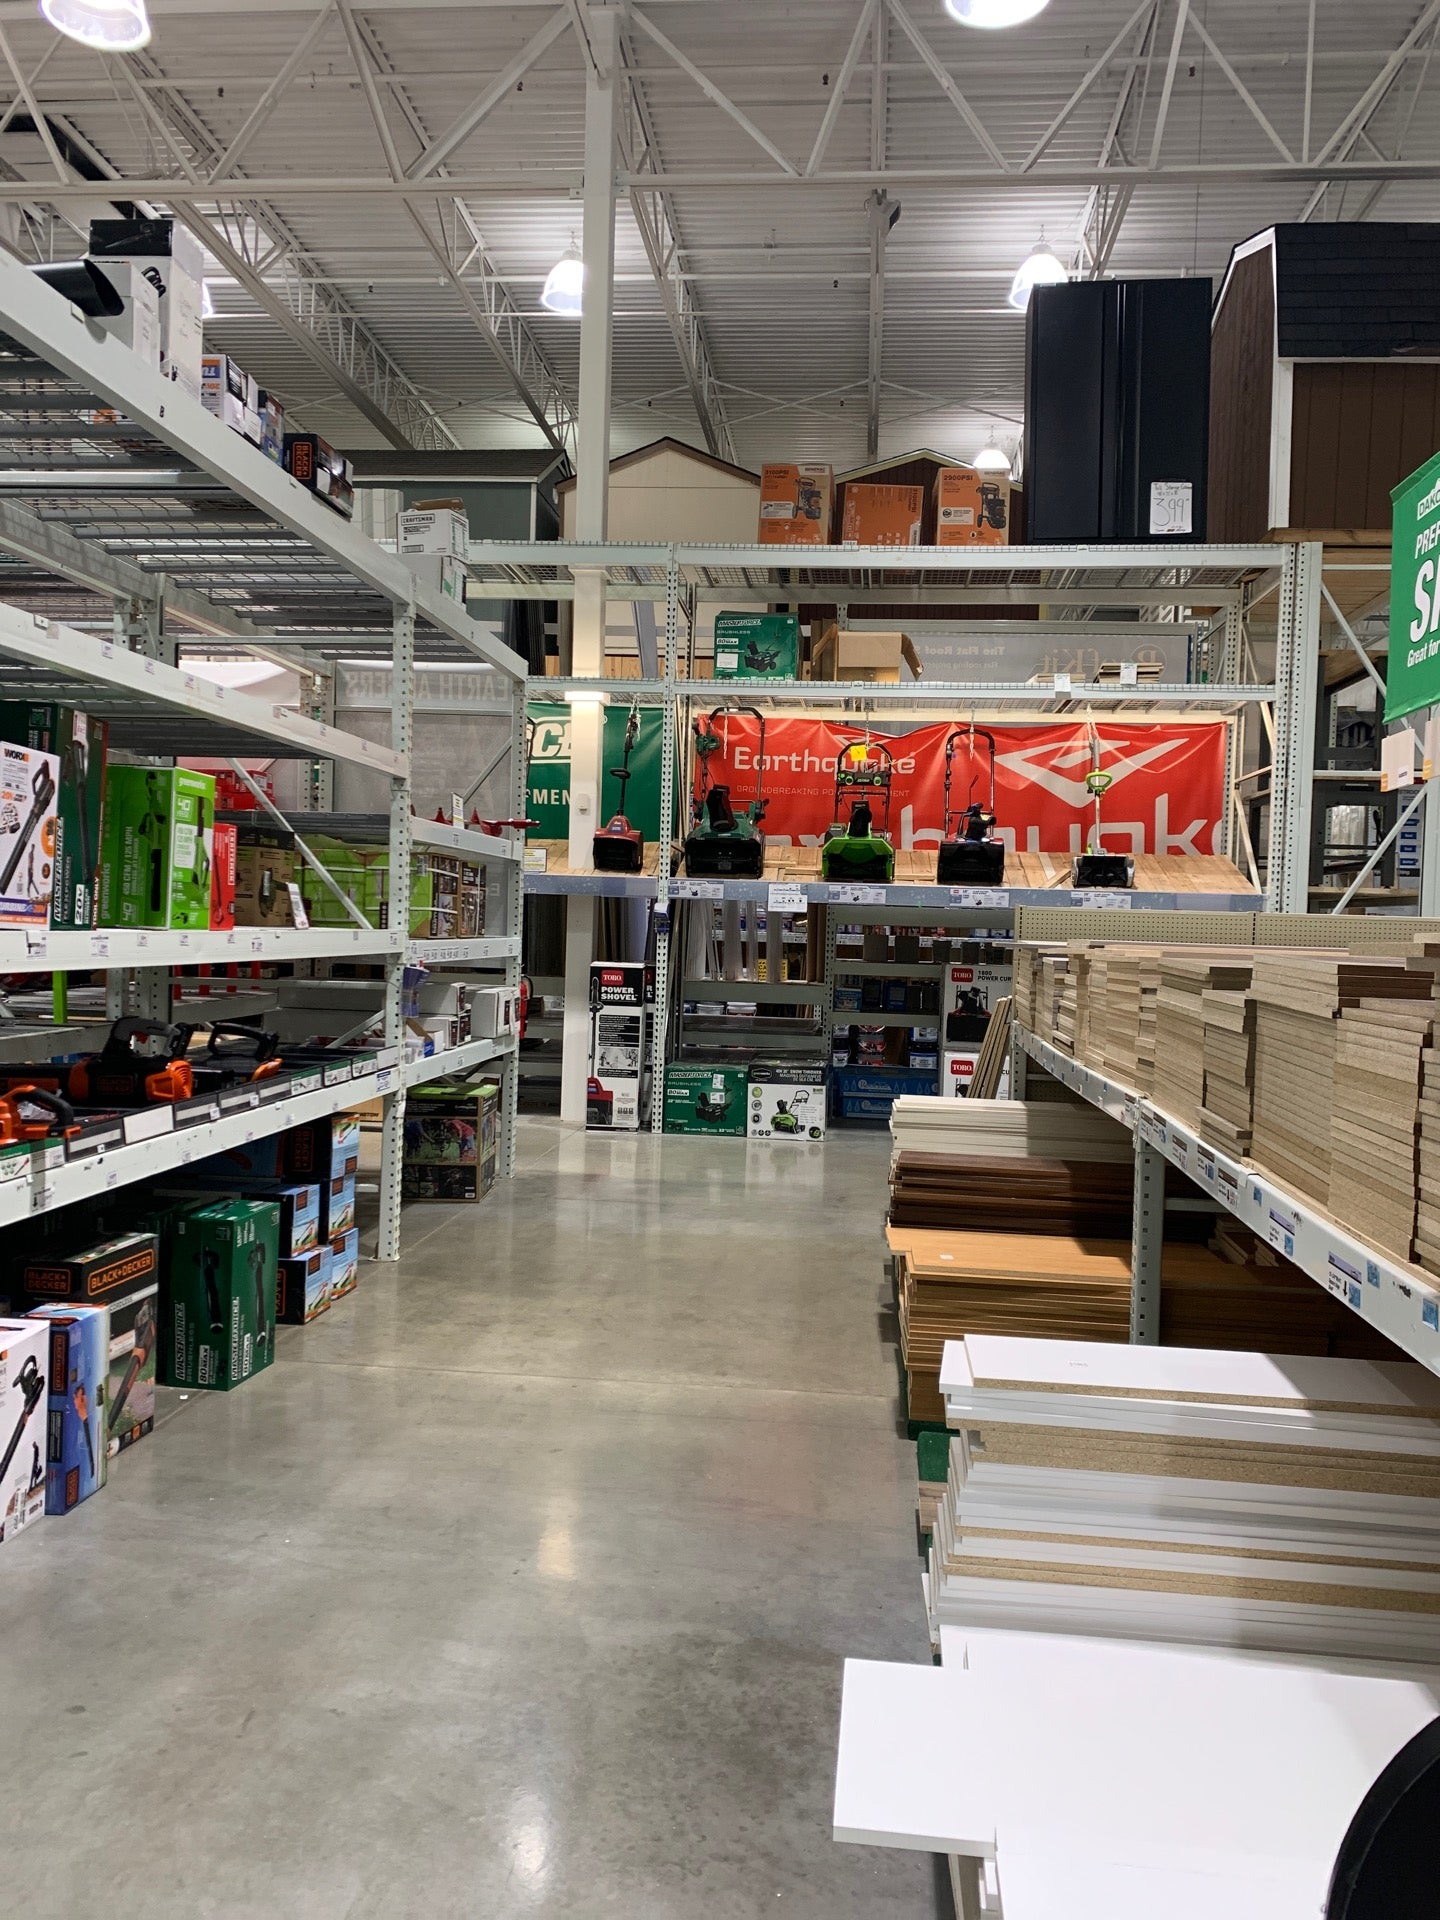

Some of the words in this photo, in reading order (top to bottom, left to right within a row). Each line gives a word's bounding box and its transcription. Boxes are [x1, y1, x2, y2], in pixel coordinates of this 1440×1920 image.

[1407, 642, 1428, 668] Great
[4, 748, 25, 761] WORX
[125, 826, 133, 844] MPH
[54, 817, 64, 922] MASTERFORCE
[101, 863, 111, 919] greenworks
[953, 971, 972, 979] TORO
[669, 1071, 712, 1079] MASTERFORCE
[28, 1271, 67, 1280] BLACK+
[28, 1280, 67, 1290] DECKER
[91, 1255, 151, 1289] BLACK+DECKER
[175, 1302, 186, 1380] MASTERFORCE
[231, 1298, 240, 1380] MASTERFORCE
[186, 1323, 195, 1383] BRUSHLESS
